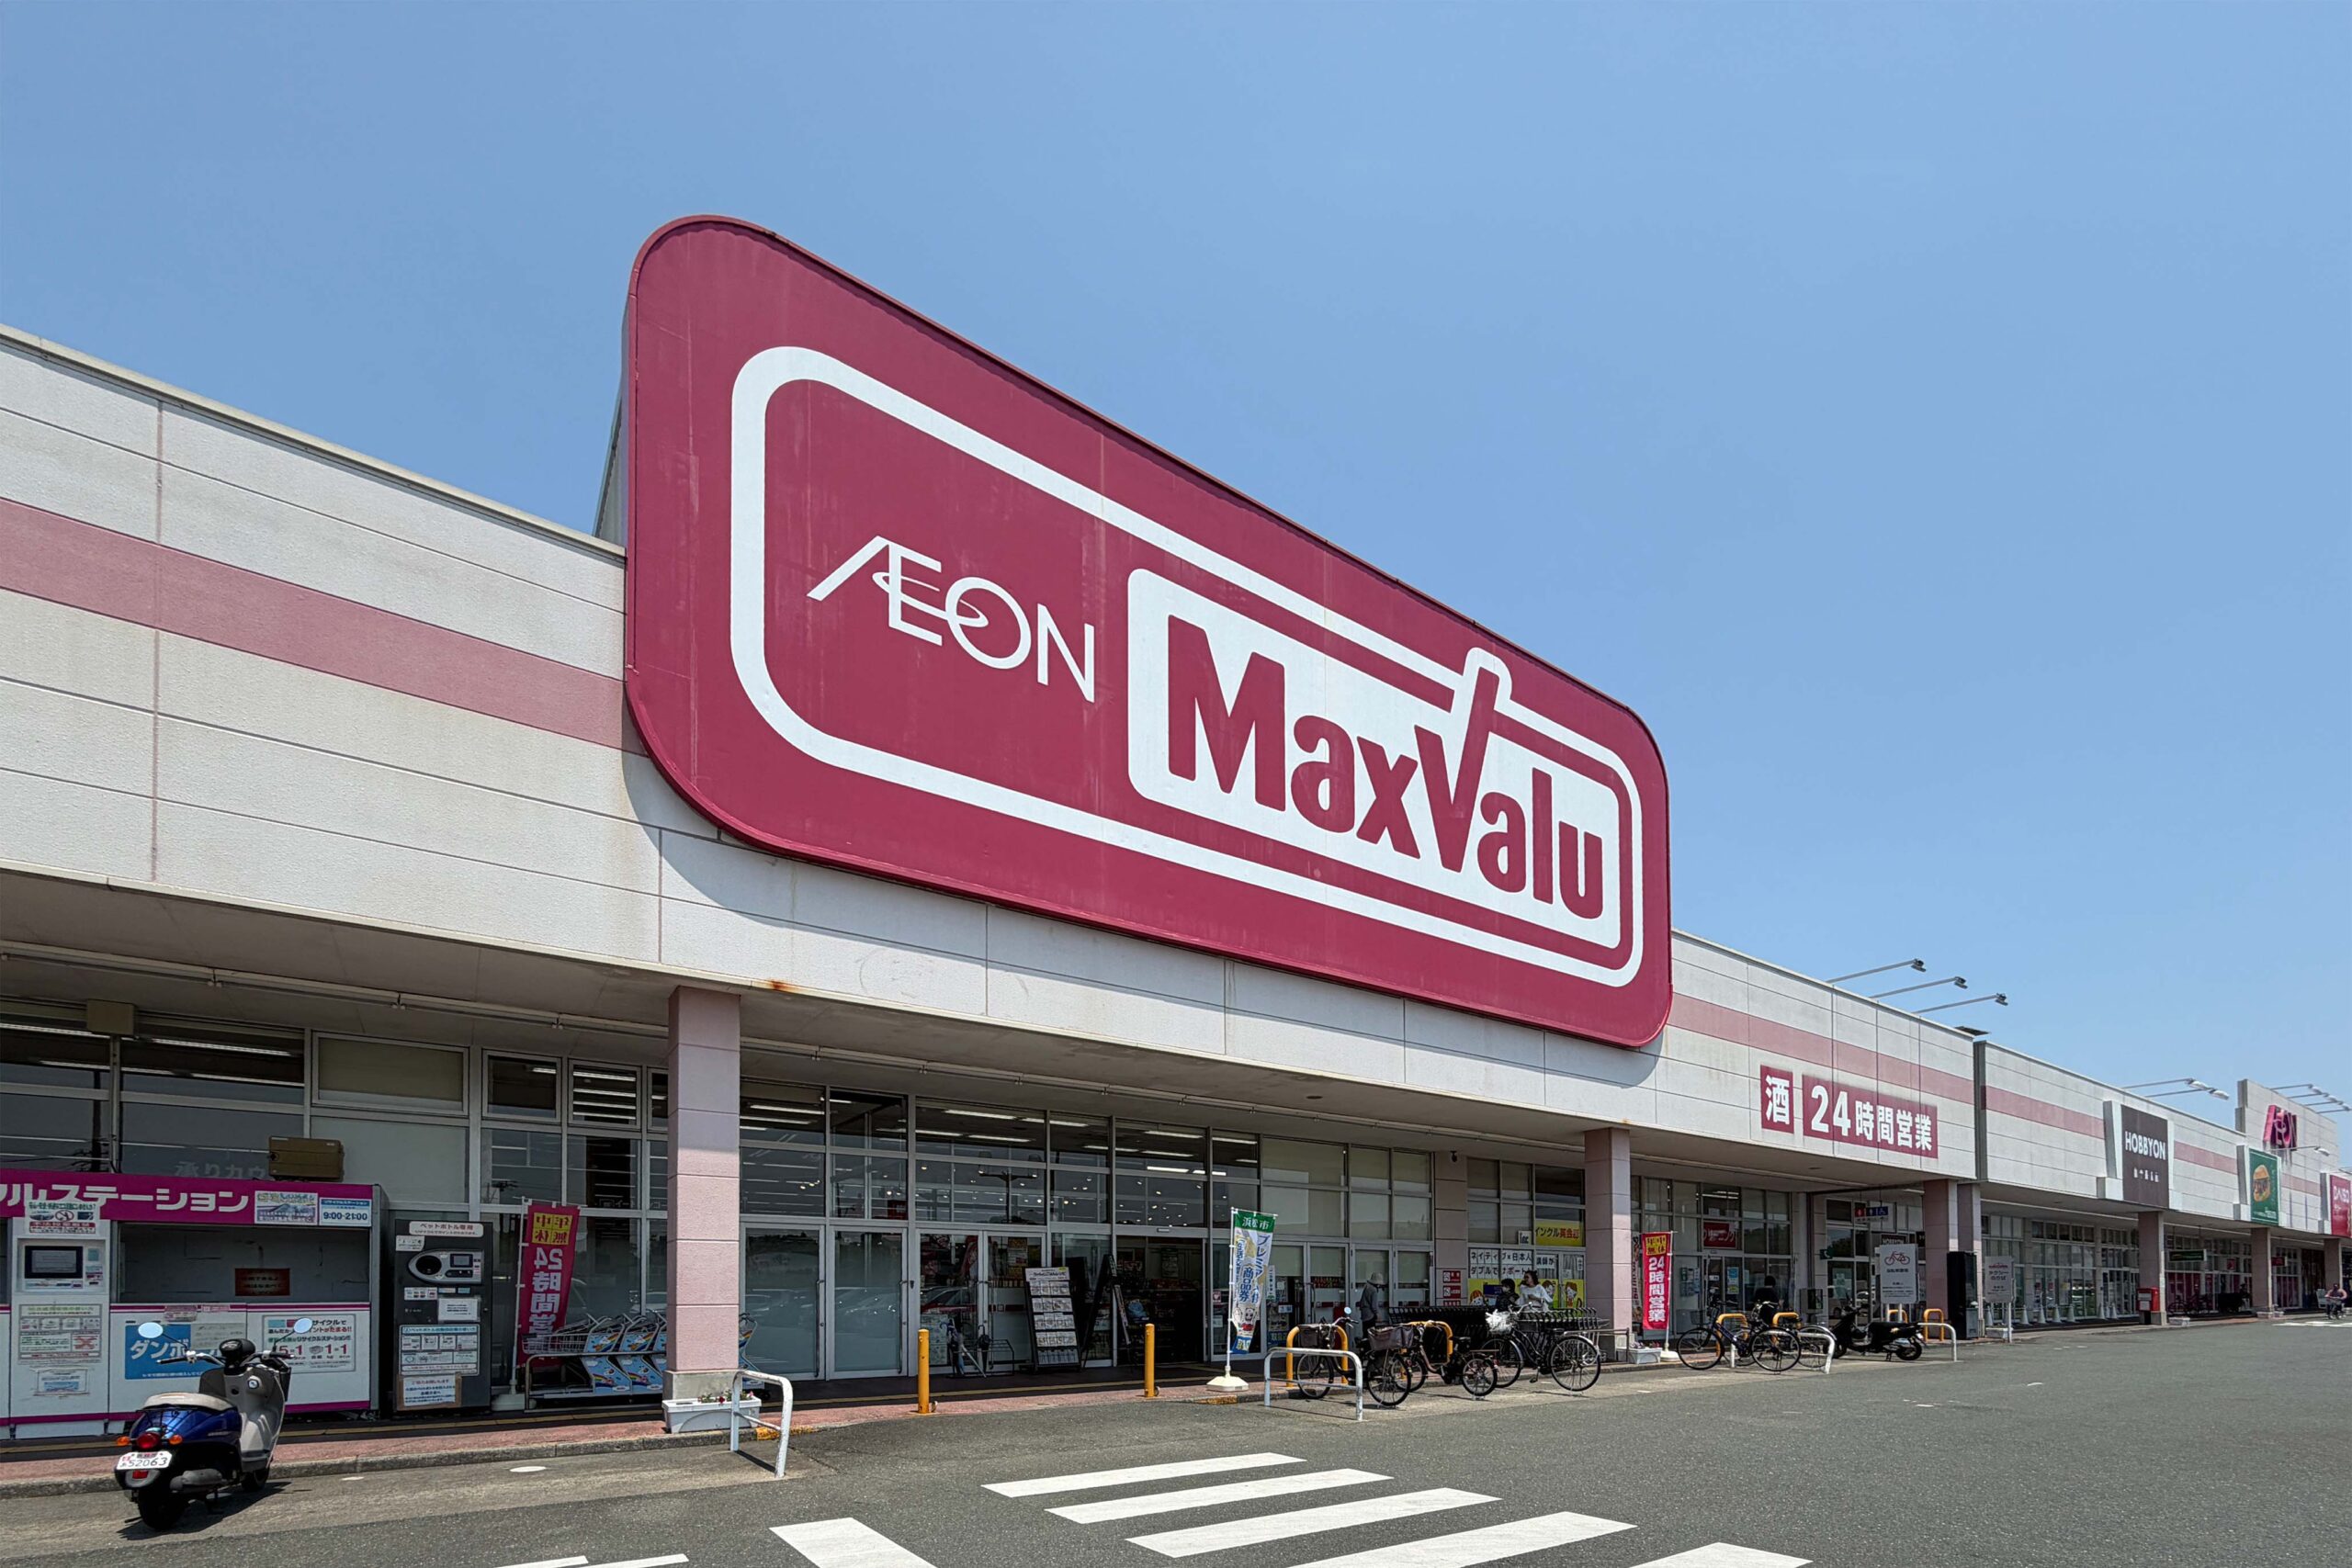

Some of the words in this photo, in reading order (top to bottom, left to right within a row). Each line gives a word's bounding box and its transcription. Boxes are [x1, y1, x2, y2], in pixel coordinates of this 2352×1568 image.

[1168, 615, 1604, 919] MaxValu
[1765, 1074, 1791, 1126] 酒
[1811, 1085, 1932, 1151] 24時間営業
[2124, 1131, 2166, 1161] HOBBYON
[0, 1183, 249, 1213] ルステーション
[1242, 1216, 1270, 1230] 浜松市
[1238, 1267, 1255, 1303] 商品券
[1648, 1256, 1666, 1322] 24時間営業
[128, 1457, 168, 1468] 52063
